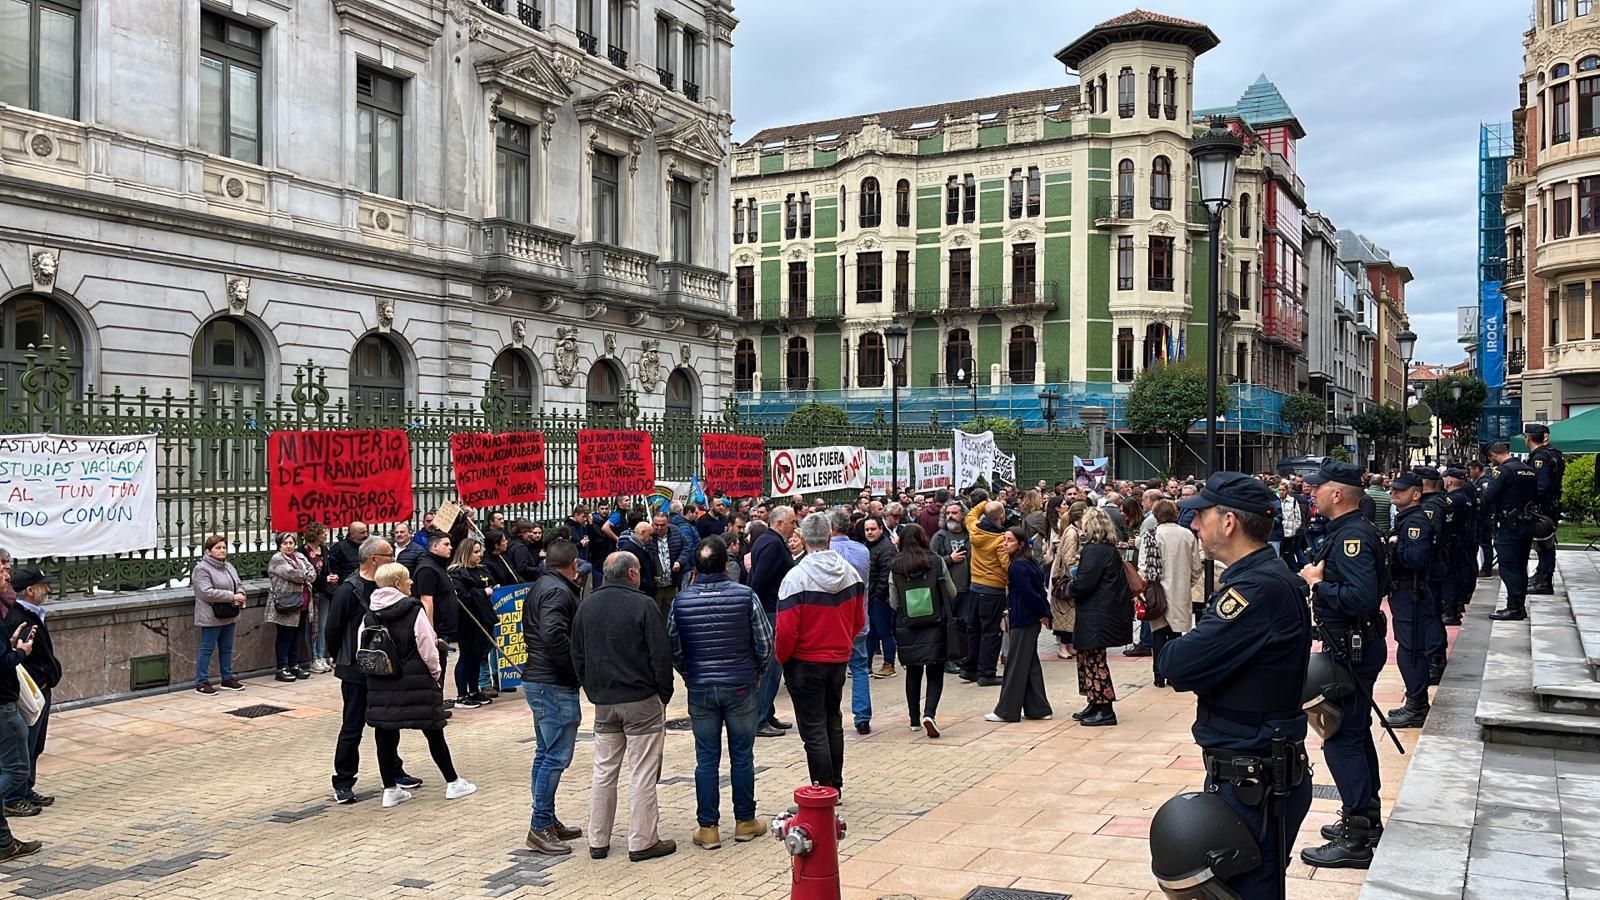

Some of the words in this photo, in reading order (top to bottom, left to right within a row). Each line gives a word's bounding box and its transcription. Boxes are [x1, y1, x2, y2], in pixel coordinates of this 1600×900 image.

[1486, 316, 1498, 352] IROCA
[0, 439, 77, 454] ASTURIAS
[88, 440, 147, 455] VACIADA
[278, 432, 403, 464] MINISTERIO
[796, 453, 818, 469] LOBO
[819, 451, 845, 466] FUERA
[502, 464, 510, 476] ES
[869, 466, 884, 476] Cadena
[932, 464, 940, 475] LEY
[496, 478, 509, 487] NO
[796, 473, 812, 488] DEL
[813, 470, 842, 486] LESPRE
[8, 486, 34, 503] AL
[56, 485, 94, 499] TUN
[507, 481, 538, 497] LOBERA
[62, 502, 133, 524] COMÚN
[502, 625, 515, 634] DE
